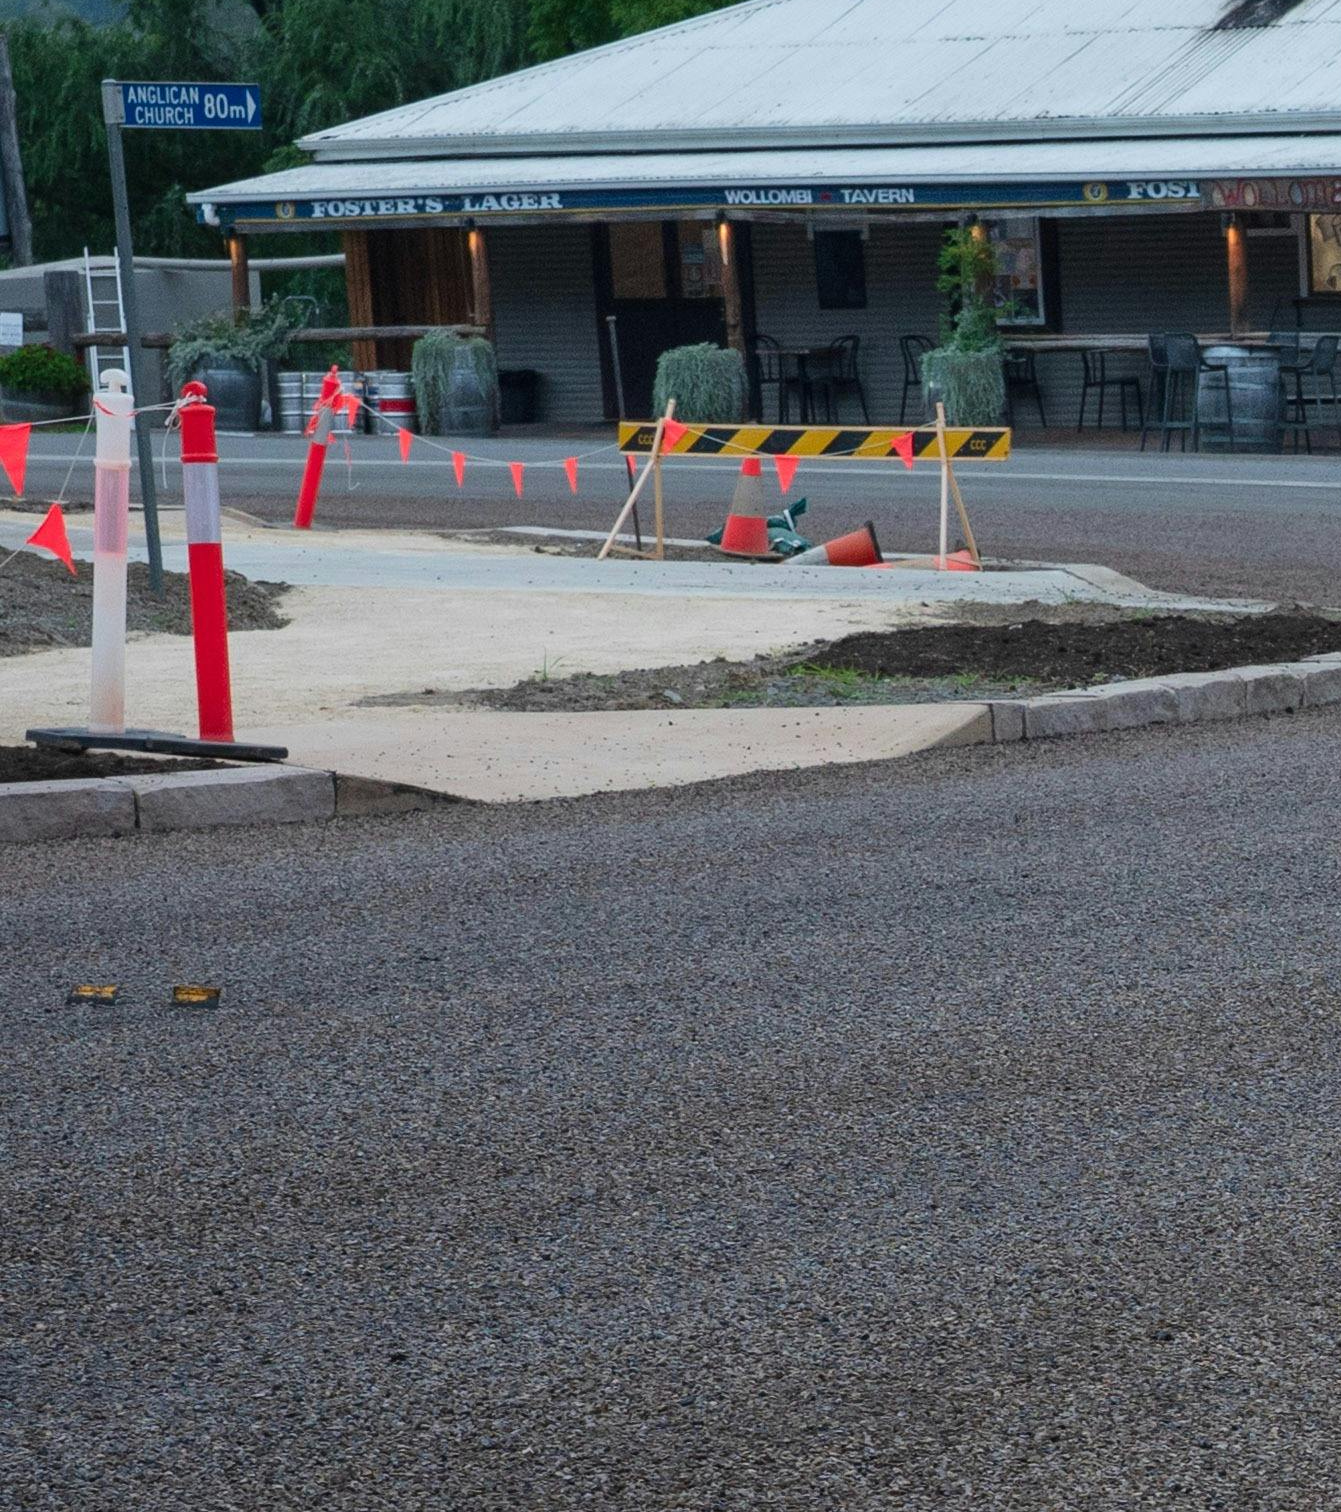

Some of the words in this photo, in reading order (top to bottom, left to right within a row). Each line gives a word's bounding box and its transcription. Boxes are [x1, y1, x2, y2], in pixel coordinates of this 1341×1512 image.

[127, 86, 200, 104] ANGLICAN
[135, 106, 194, 125] CHURCH
[203, 93, 246, 119] 80m
[311, 197, 444, 218] FOSTER'S
[461, 192, 564, 212] LAGER
[724, 189, 813, 204] WOLLOMBI
[840, 188, 915, 204] TAVERN
